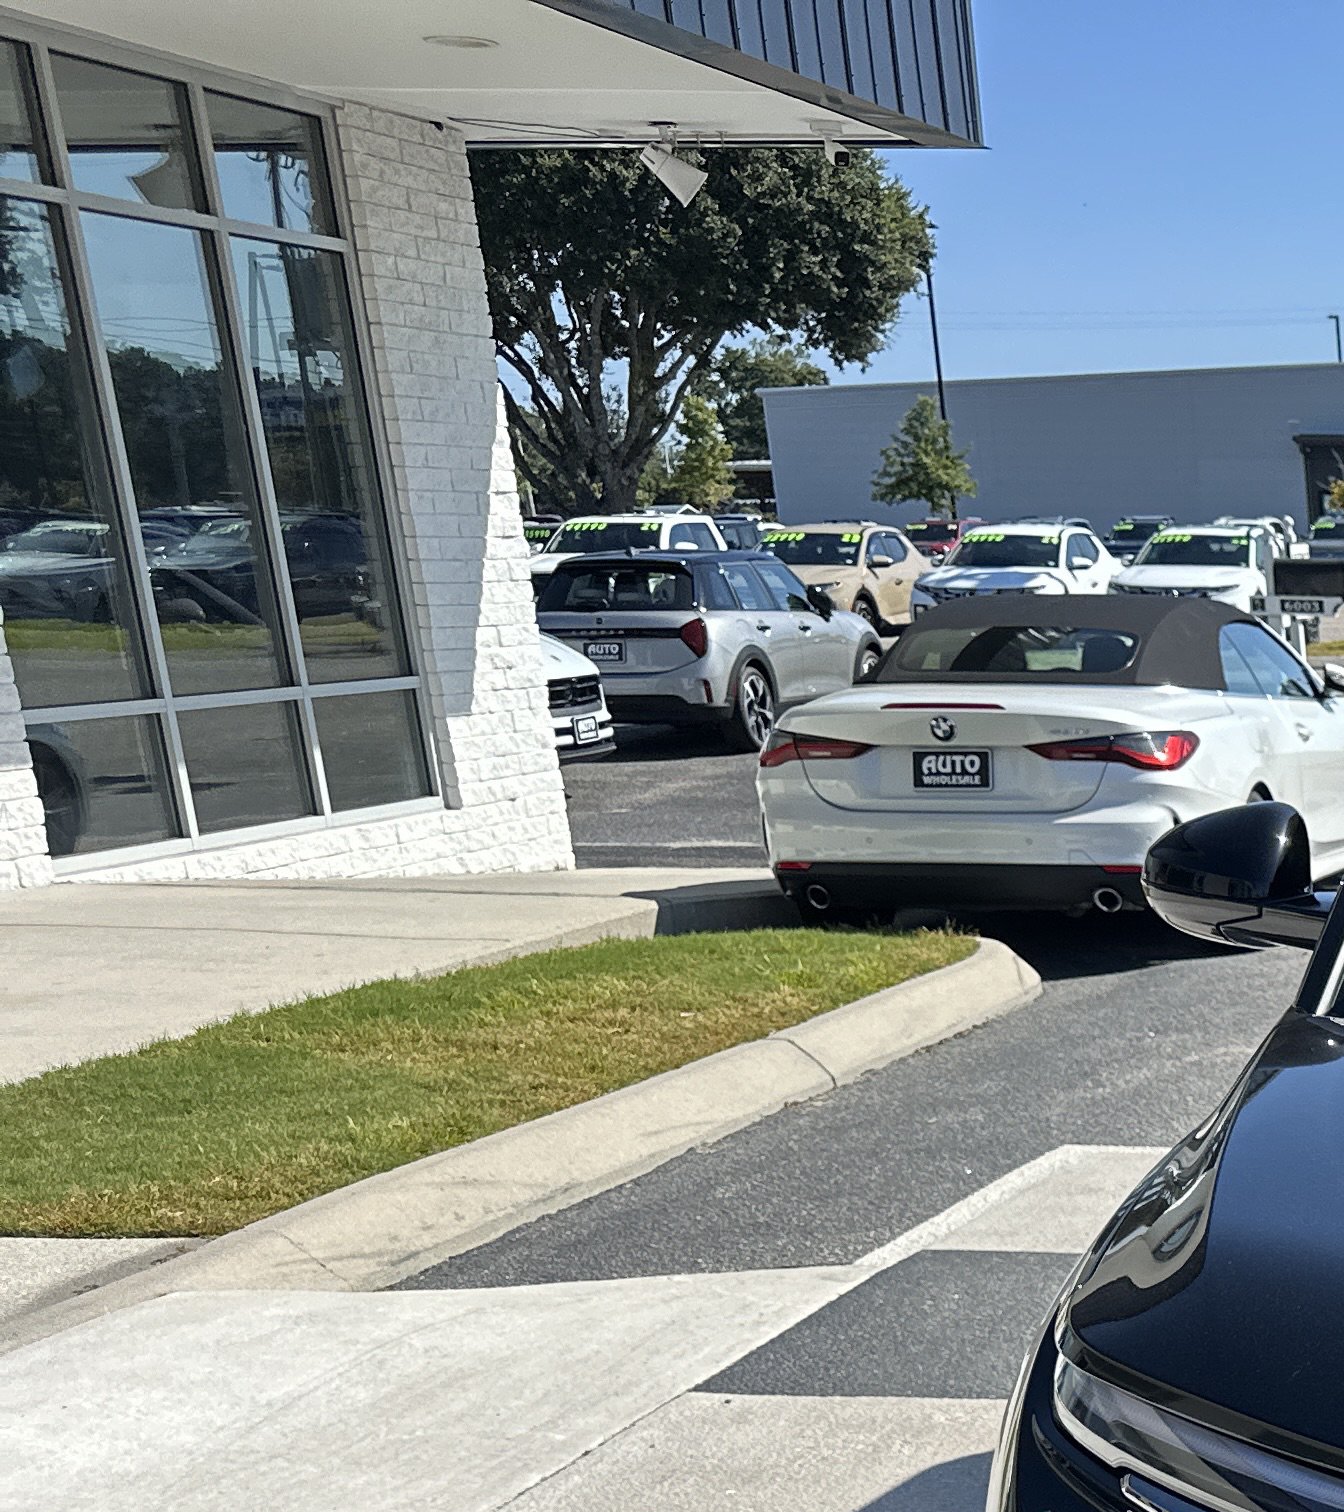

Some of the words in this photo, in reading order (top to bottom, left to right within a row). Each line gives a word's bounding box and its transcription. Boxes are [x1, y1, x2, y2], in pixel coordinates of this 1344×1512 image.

[587, 644, 619, 655] AUTO
[922, 755, 981, 774] AUTO
[922, 775, 982, 785] WHOLESALE
